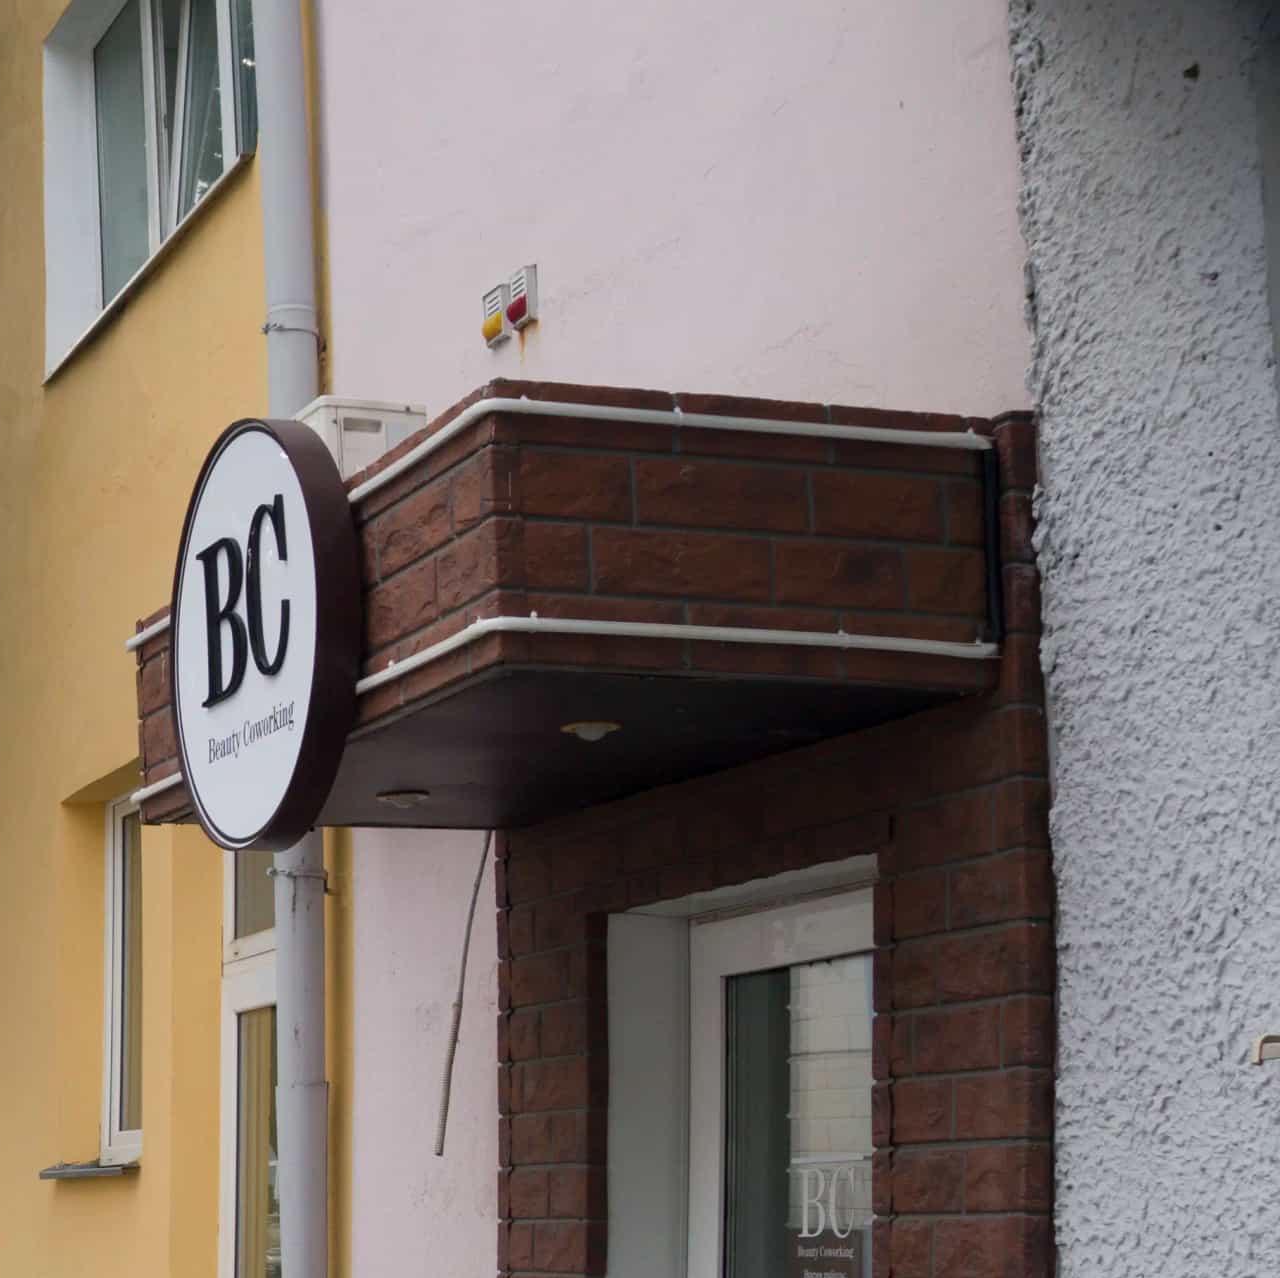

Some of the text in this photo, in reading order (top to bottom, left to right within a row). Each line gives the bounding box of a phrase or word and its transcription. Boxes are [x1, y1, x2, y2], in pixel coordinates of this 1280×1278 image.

[196, 494, 290, 708] BC
[208, 701, 295, 764] Beauty Coworking
[798, 1168, 855, 1238] BC
